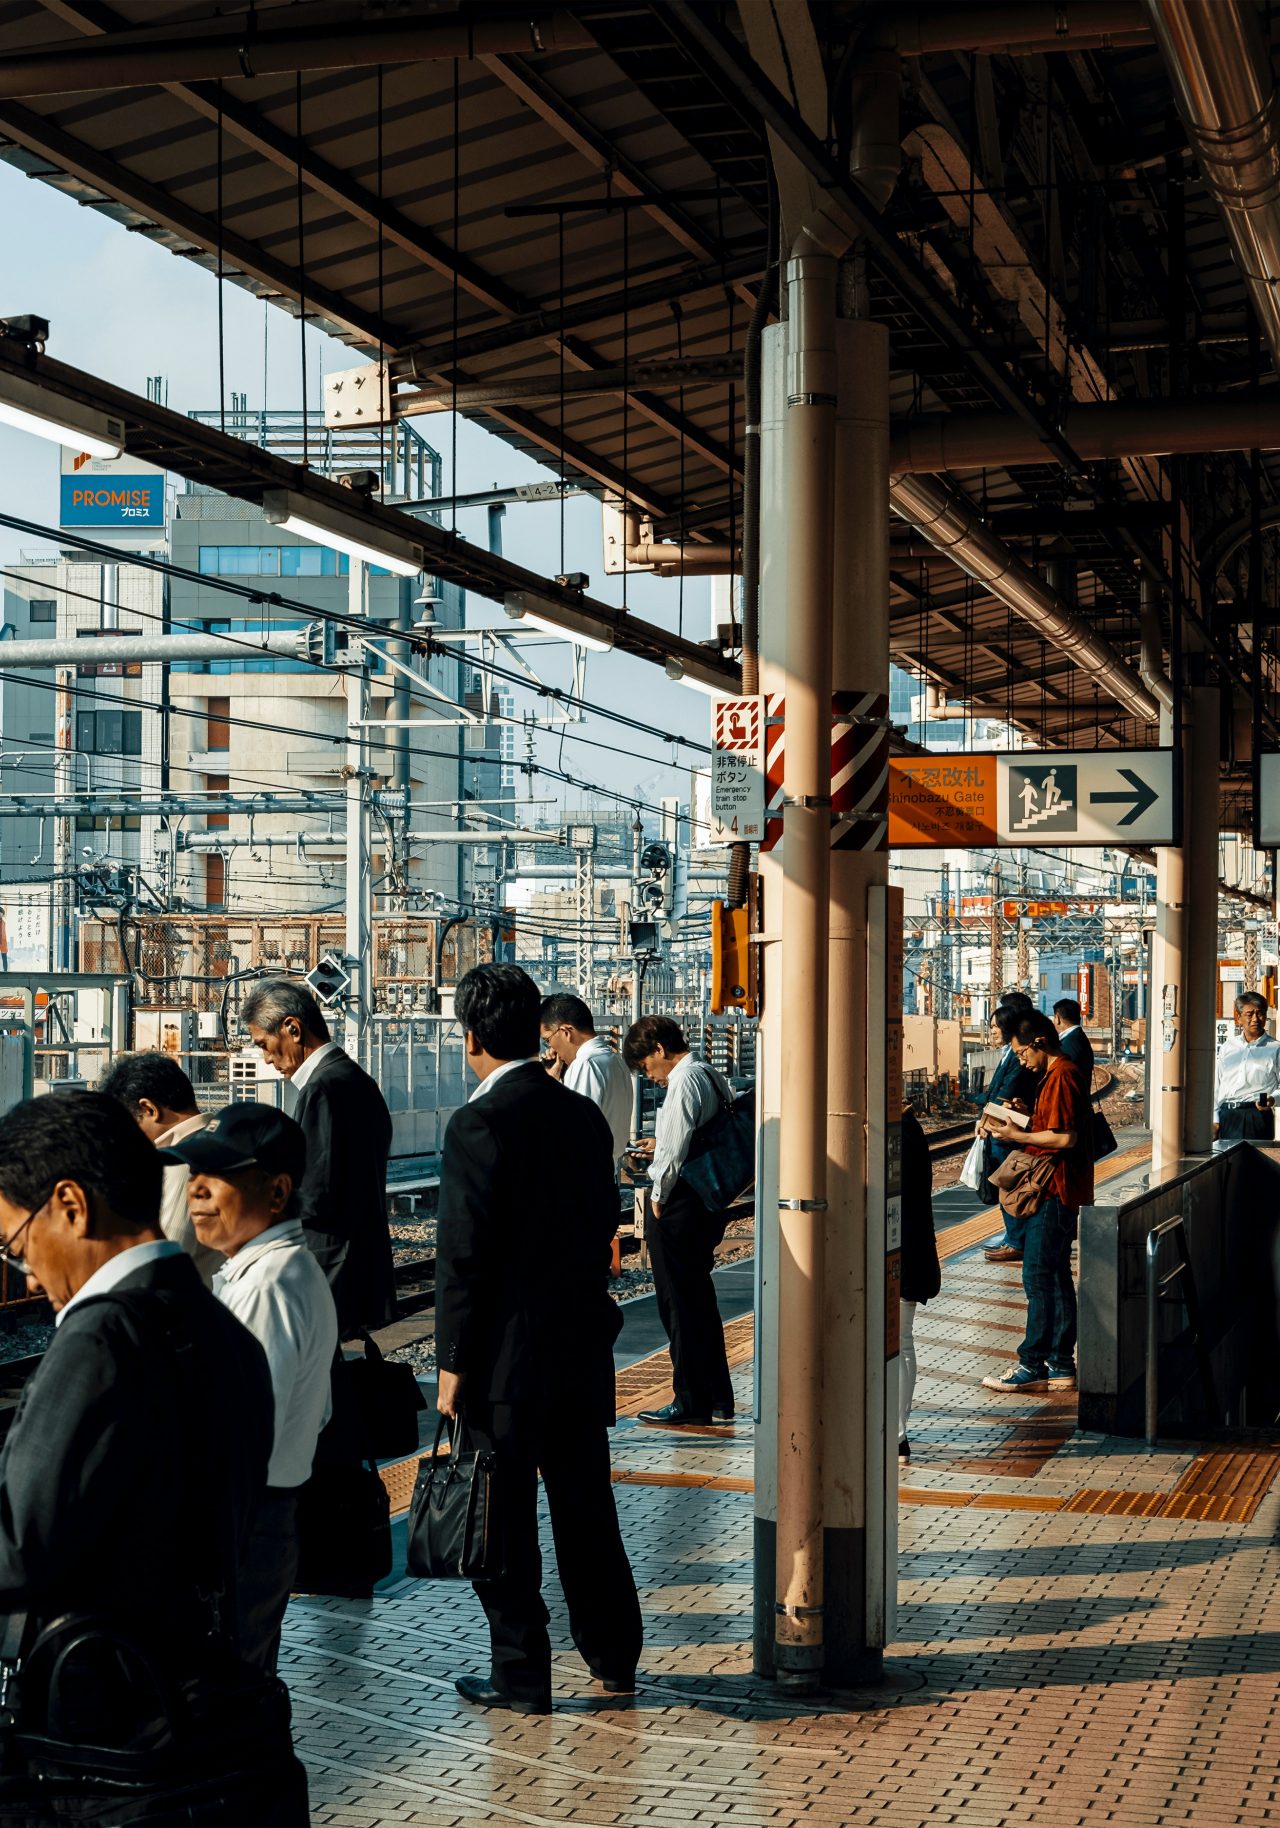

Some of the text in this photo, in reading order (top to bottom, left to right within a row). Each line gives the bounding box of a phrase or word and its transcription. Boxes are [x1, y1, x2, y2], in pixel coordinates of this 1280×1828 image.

[72, 490, 151, 507] PROMISE
[121, 507, 150, 518] プロミス
[716, 755, 758, 769] 非常停止
[716, 771, 747, 784] ボタン
[897, 767, 985, 789] 不忍改札
[715, 786, 751, 794] Emergency
[715, 794, 748, 803] train stop
[953, 791, 985, 803] Gate
[715, 804, 737, 812] button
[730, 815, 739, 836] 4
